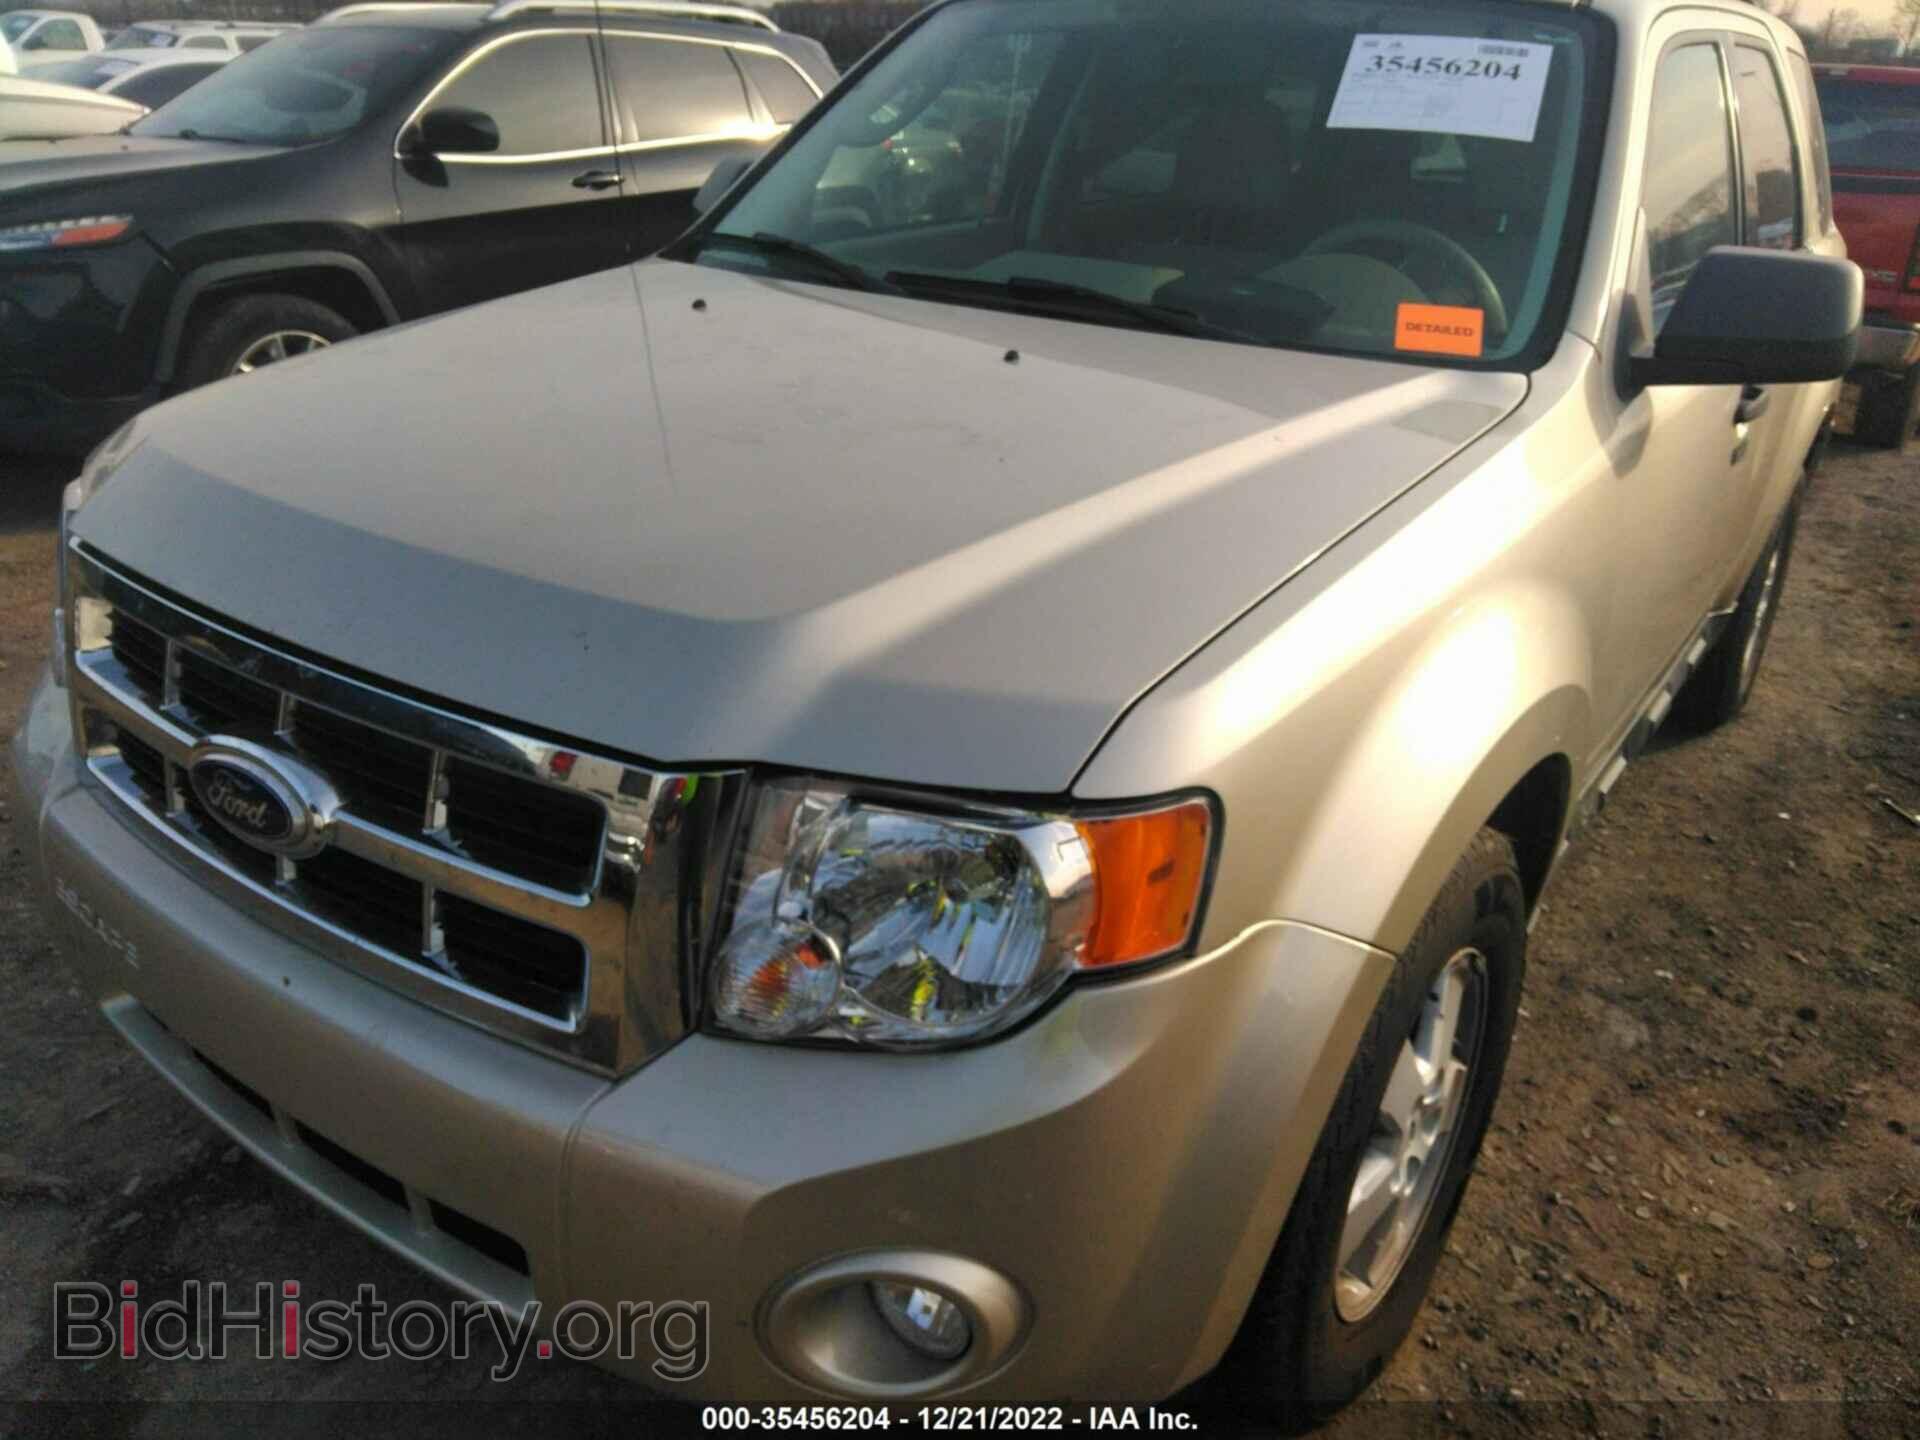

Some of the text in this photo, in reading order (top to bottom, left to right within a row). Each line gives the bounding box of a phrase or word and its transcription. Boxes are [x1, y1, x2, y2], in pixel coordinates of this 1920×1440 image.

[1364, 54, 1521, 81] 35456204
[1405, 321, 1474, 336] DETAILED
[208, 768, 267, 827] Ford
